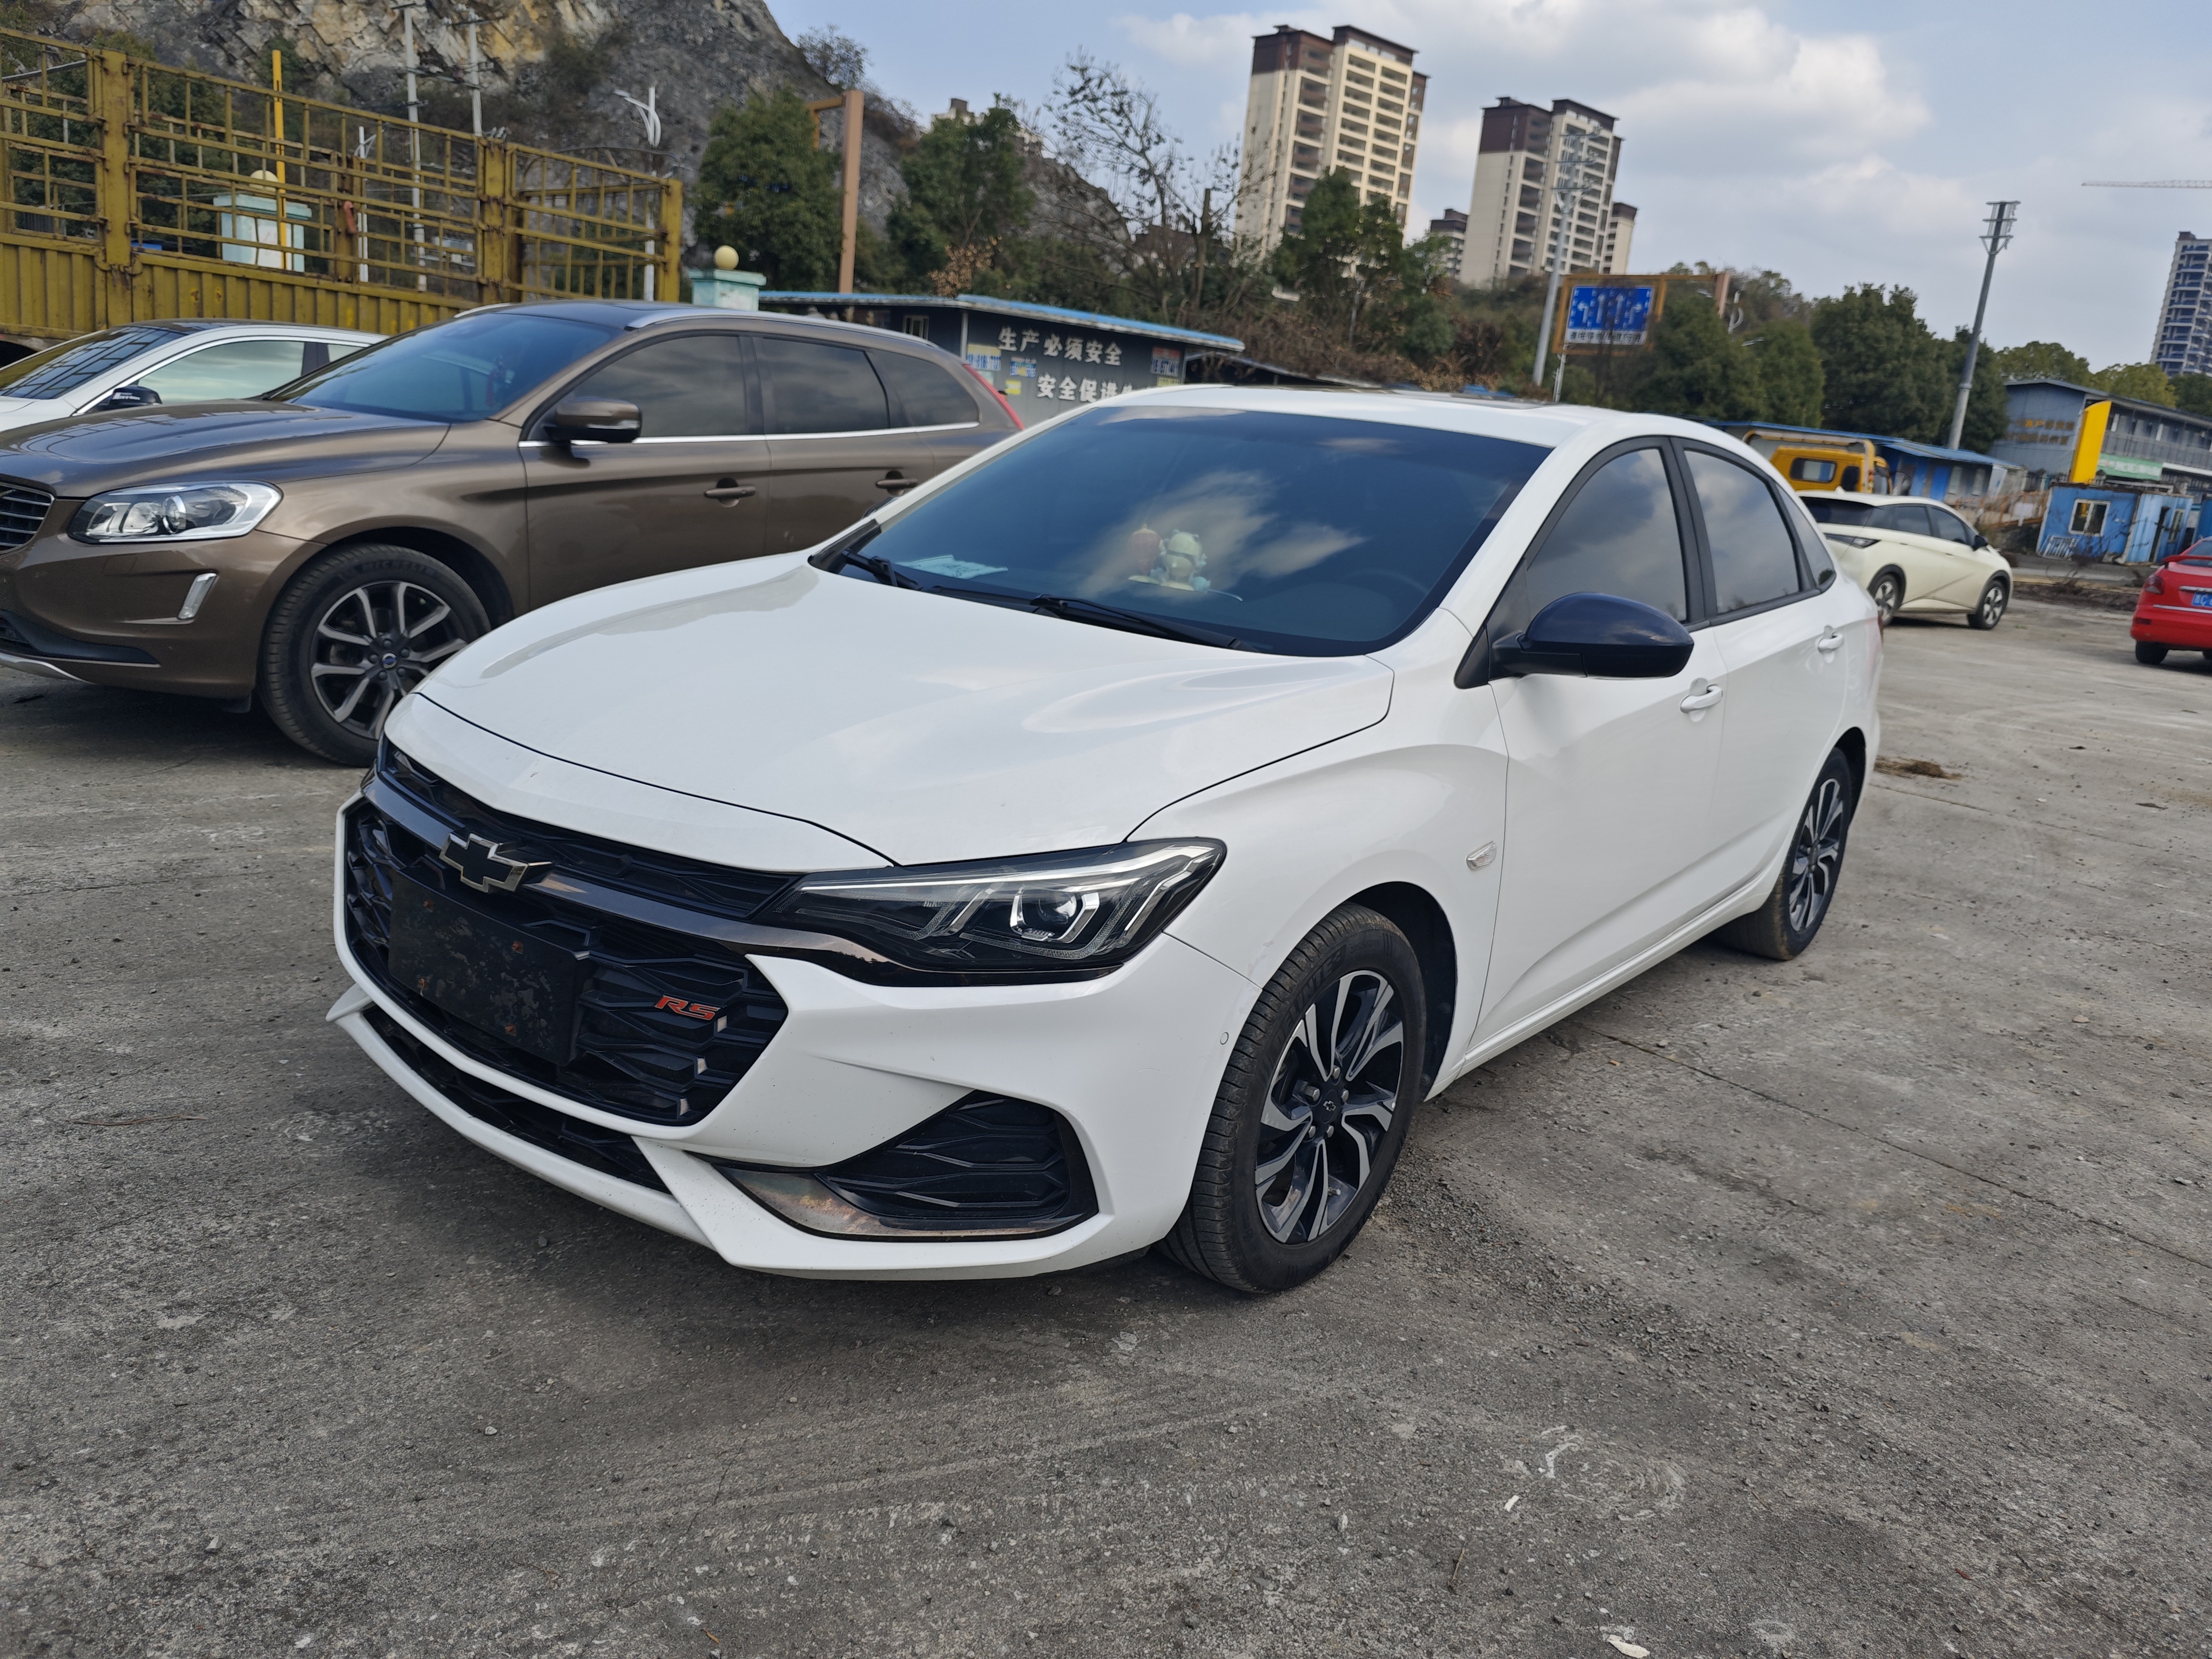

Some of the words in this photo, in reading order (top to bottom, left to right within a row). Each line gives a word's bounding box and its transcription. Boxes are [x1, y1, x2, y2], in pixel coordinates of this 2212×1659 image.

[998, 326, 1123, 366] 生产必须安全
[655, 994, 721, 1021] RS
